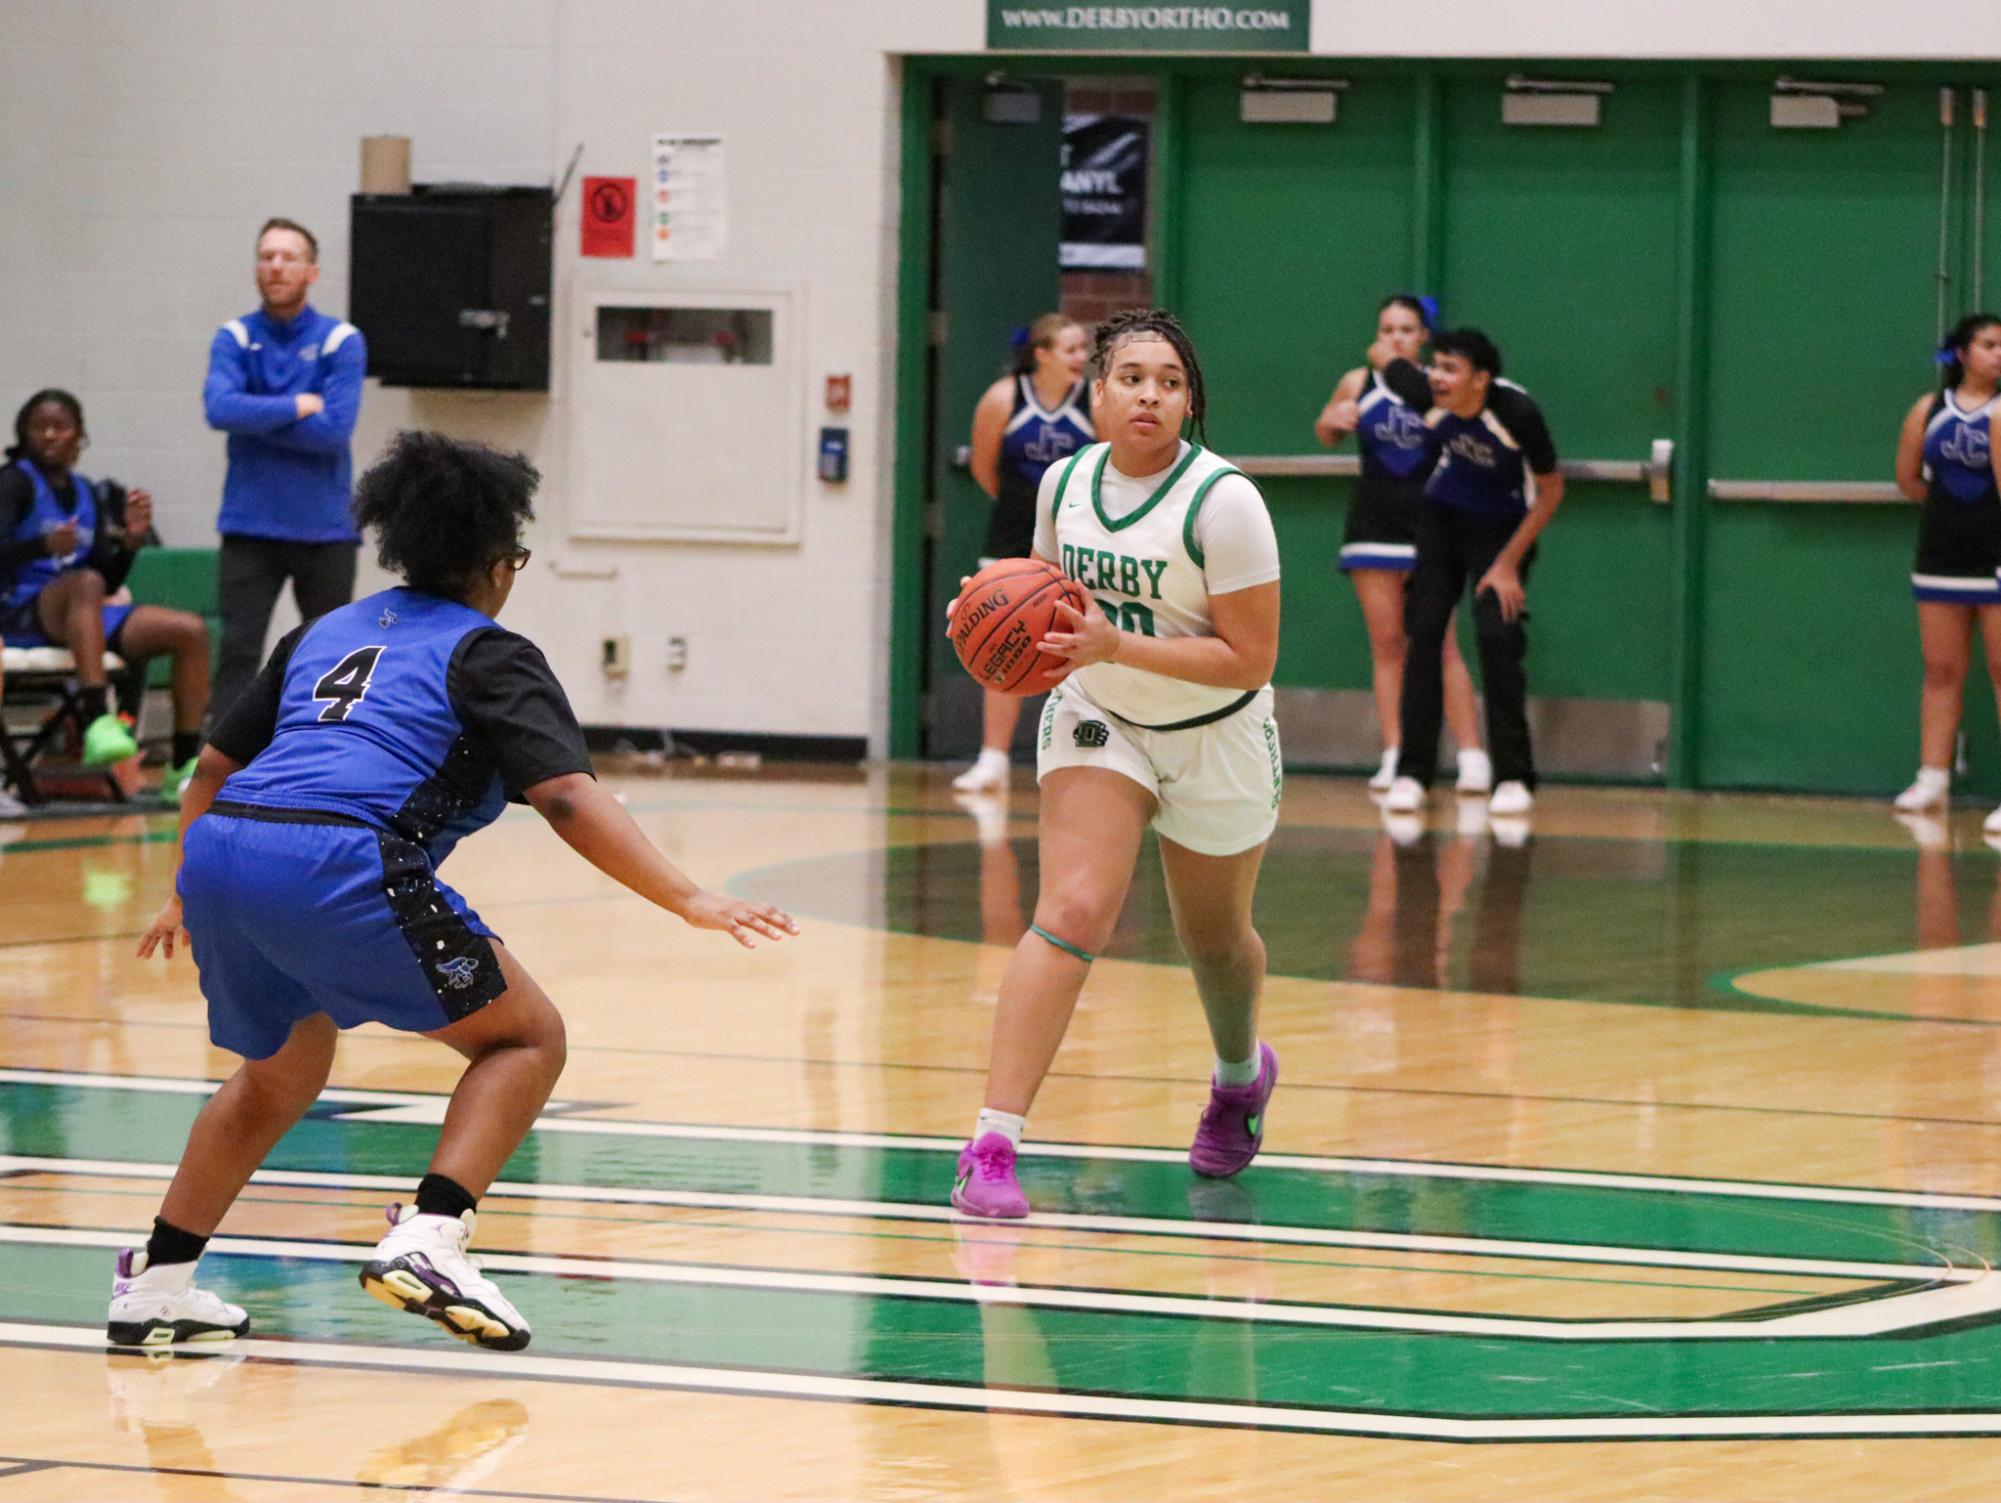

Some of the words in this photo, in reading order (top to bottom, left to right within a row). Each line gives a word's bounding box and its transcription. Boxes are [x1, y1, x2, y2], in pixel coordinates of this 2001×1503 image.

[1062, 542, 1168, 600] DERBY
[978, 618, 1027, 681] LEGACY
[1001, 634, 1032, 675] 1000
[312, 645, 387, 722] 4
